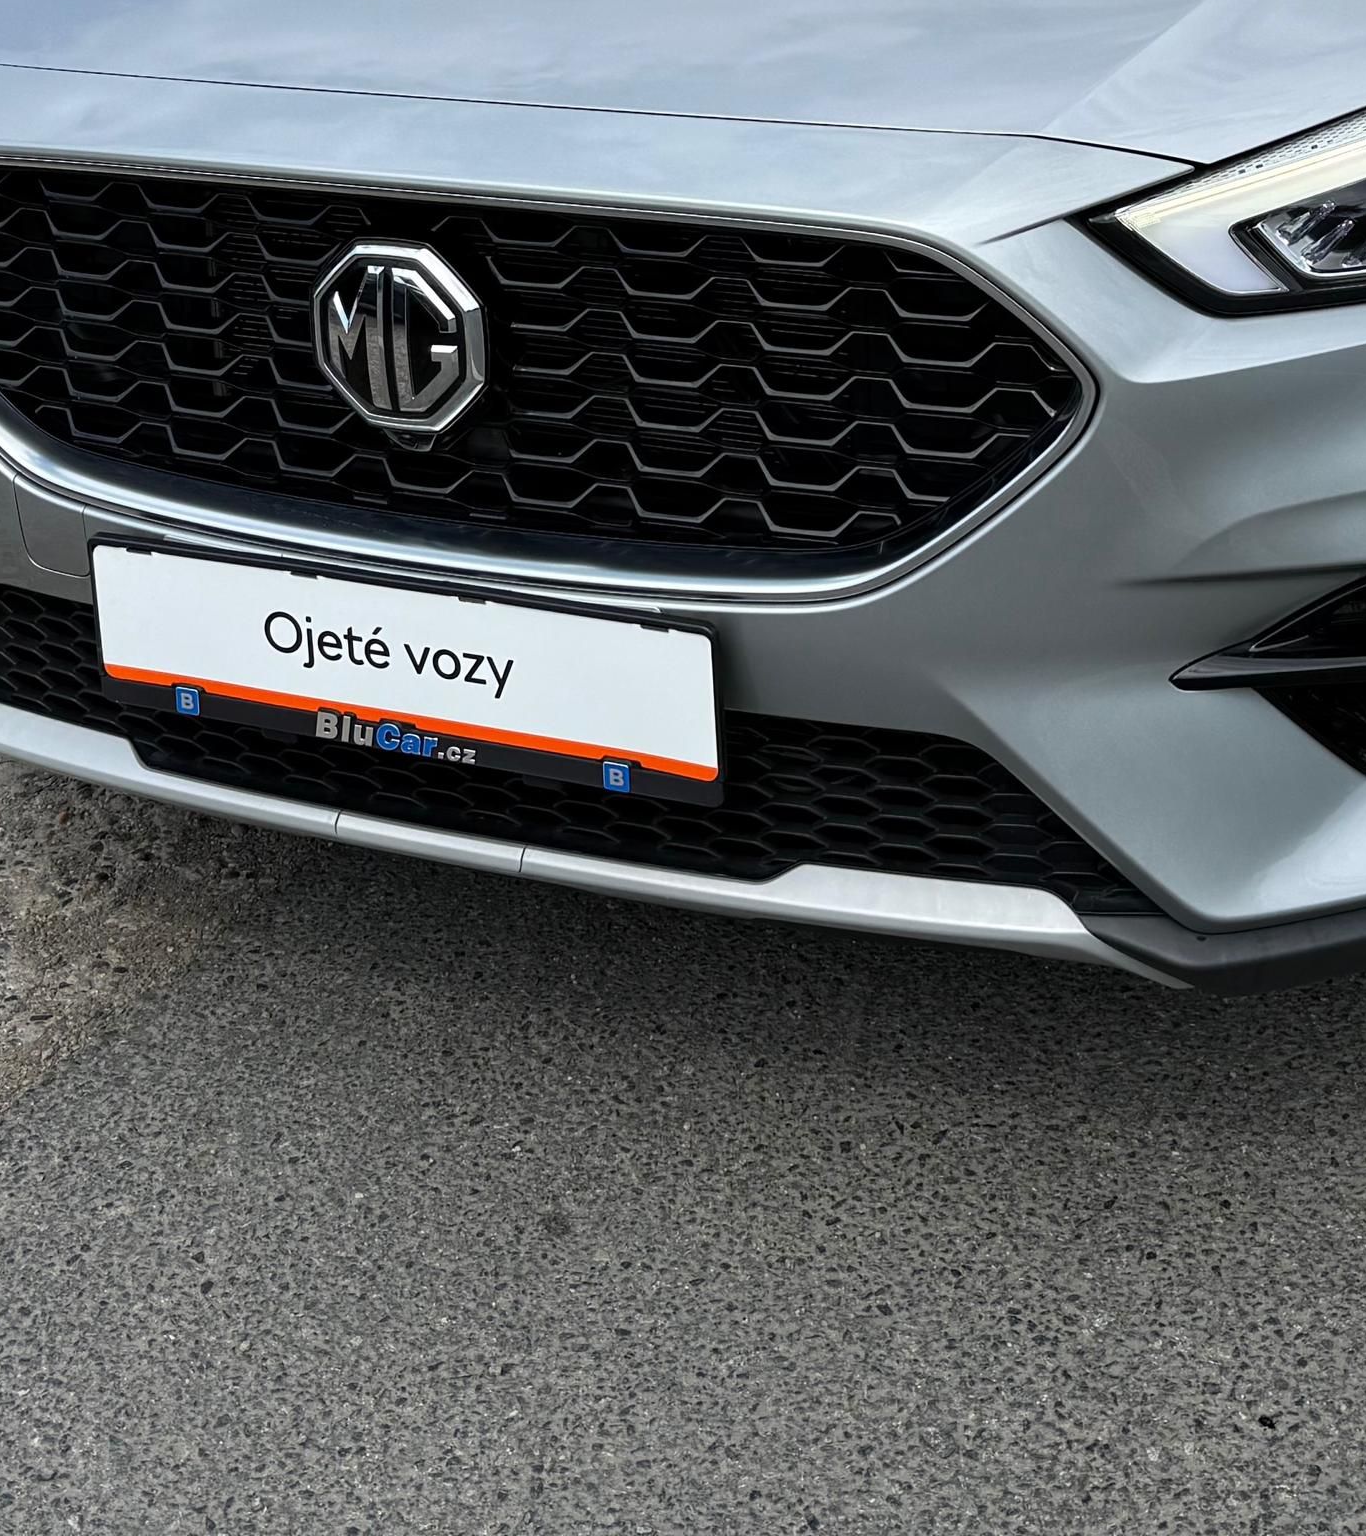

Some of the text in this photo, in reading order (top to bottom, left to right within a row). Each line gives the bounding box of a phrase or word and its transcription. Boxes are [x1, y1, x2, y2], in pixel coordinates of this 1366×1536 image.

[328, 265, 460, 412] MG
[264, 610, 514, 699] Ojeté vozy
[181, 692, 195, 710] B
[315, 710, 477, 765] BluCar.cz
[609, 767, 625, 786] B
